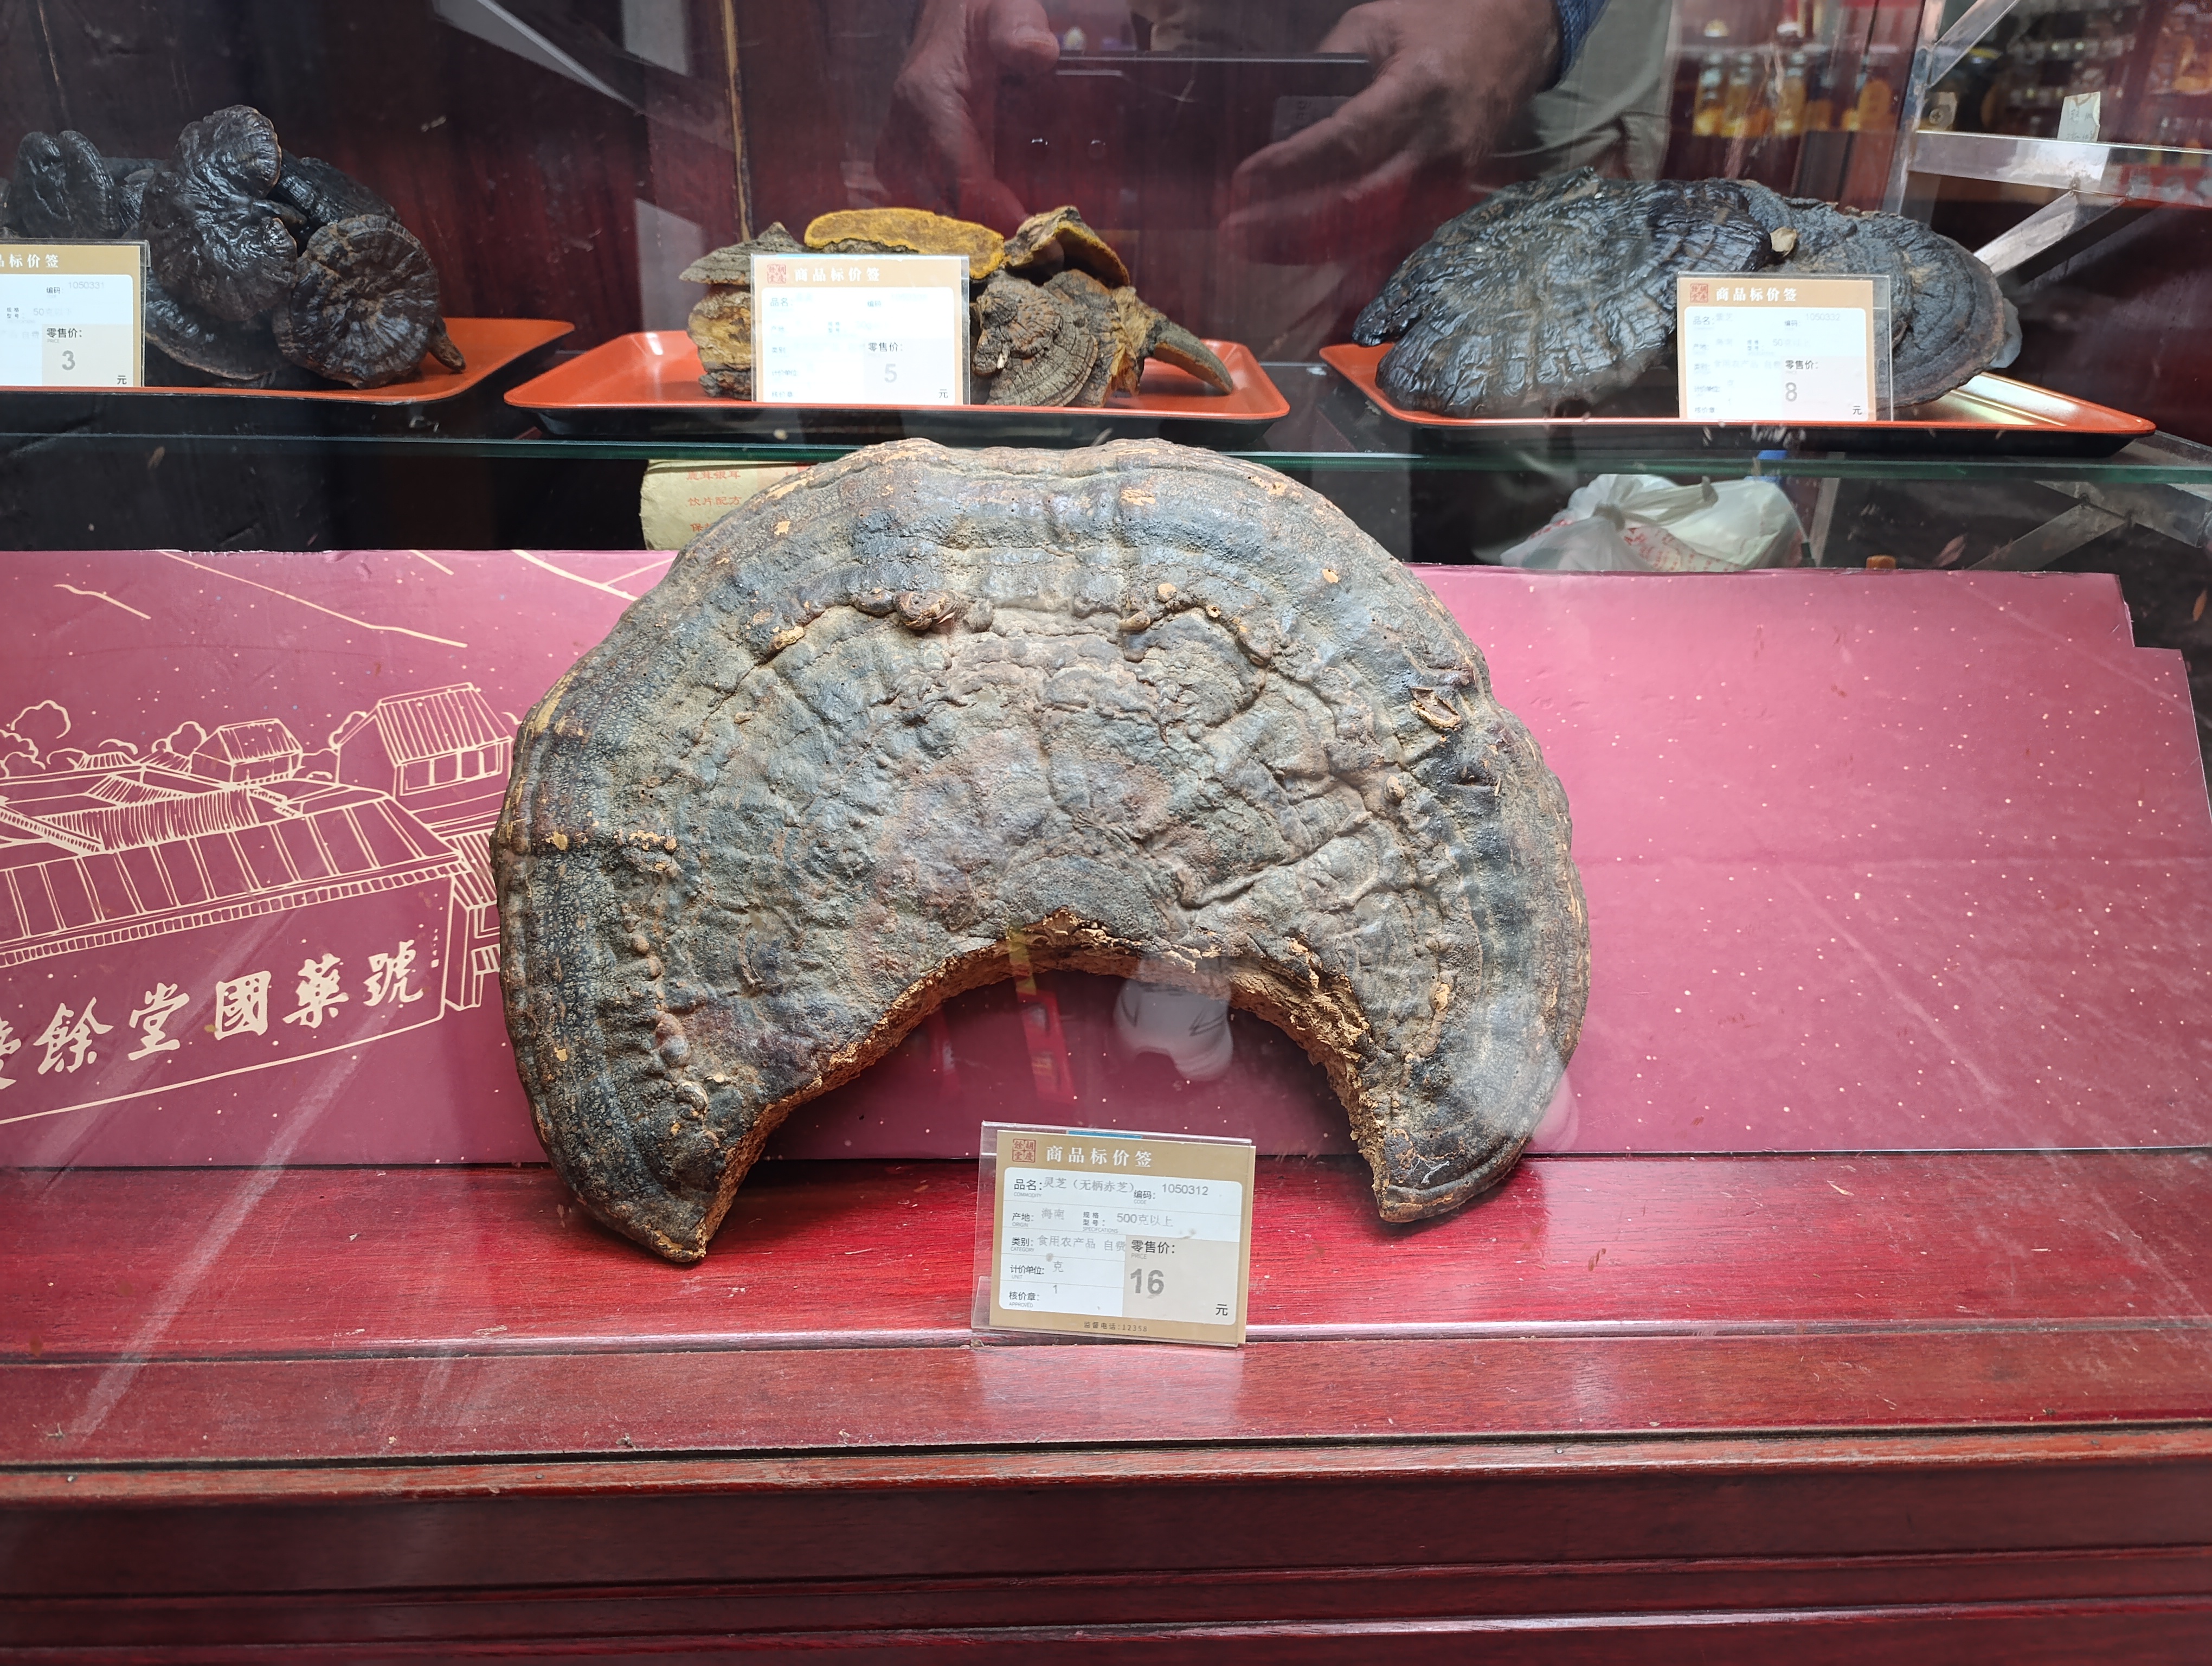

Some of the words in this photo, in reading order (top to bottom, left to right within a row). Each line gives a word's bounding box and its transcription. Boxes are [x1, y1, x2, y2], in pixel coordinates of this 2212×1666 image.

[795, 267, 879, 281] 商品标价签
[1716, 287, 1797, 302] 商品标价签
[1806, 313, 1840, 321] 1050332
[47, 328, 82, 338] 零售价：
[868, 342, 903, 353] 零售价：
[61, 350, 76, 371] 3
[1785, 360, 1819, 370] 零售价：
[117, 375, 127, 385] 元
[884, 363, 898, 383] 5
[938, 389, 949, 399] 元
[1785, 382, 1798, 402] 8
[1852, 406, 1862, 415] 元
[688, 496, 742, 507] 饮片配方
[1046, 1145, 1152, 1168] 商品标价签
[1014, 1178, 1043, 1191] 品名：
[1133, 1190, 1156, 1200] 编码：
[1162, 1183, 1209, 1196] 1050312
[1012, 1213, 1034, 1222] 产地：
[1041, 1208, 1065, 1220] 海南
[1117, 1213, 1173, 1227] 500克以上
[1012, 1237, 1034, 1247] 类别：
[1037, 1234, 1096, 1250] 食用农产品
[1104, 1239, 1126, 1252] 自费
[1131, 1240, 1175, 1254] 零售价：
[1010, 1264, 1045, 1275] 计价单位：
[1052, 1260, 1064, 1273] 克
[1130, 1268, 1165, 1295] 16
[1008, 1291, 1040, 1302] 核价章：
[1052, 1284, 1058, 1295] 1
[1215, 1303, 1229, 1316] 元
